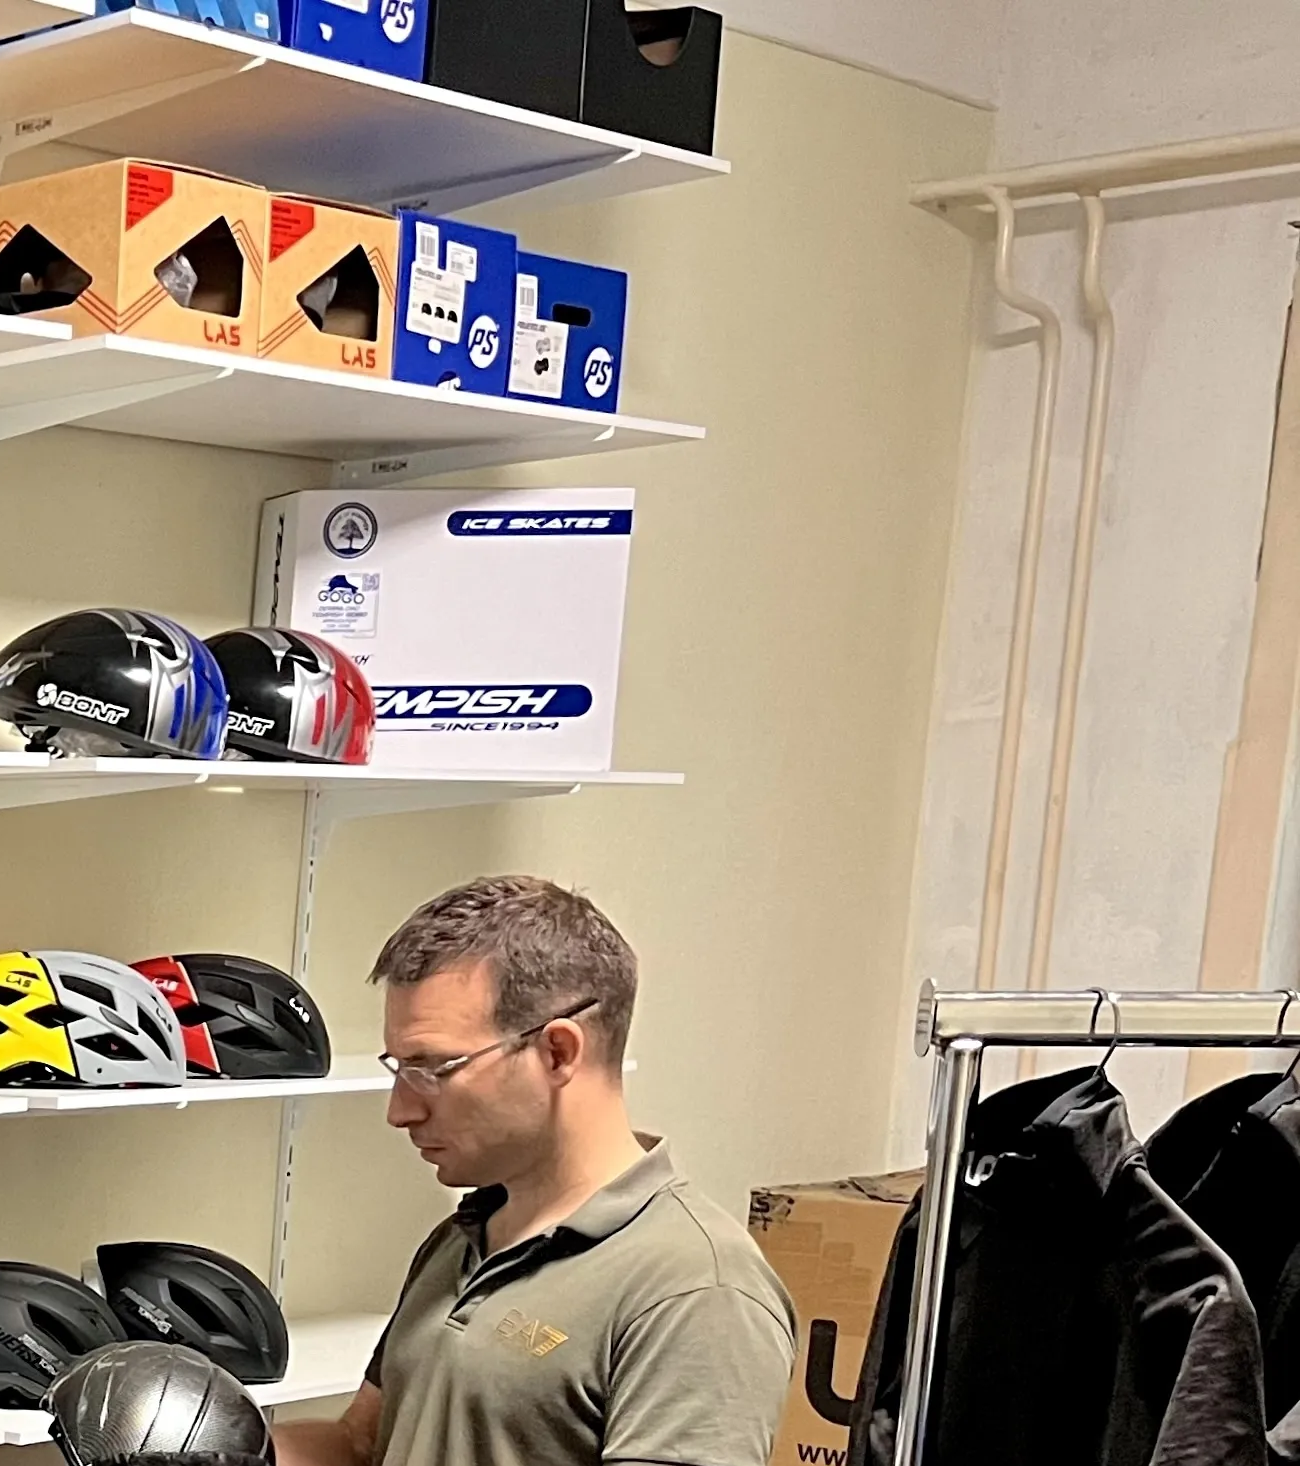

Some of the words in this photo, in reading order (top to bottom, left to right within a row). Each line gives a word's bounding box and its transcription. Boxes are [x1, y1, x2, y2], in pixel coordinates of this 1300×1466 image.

[203, 321, 241, 347] LAS
[469, 328, 499, 355] PS
[342, 343, 377, 369] LAS
[585, 360, 613, 386] PS
[462, 518, 504, 530] ICE
[507, 517, 611, 529] SKATES
[318, 590, 365, 604] GOGO
[54, 691, 129, 725] BONT
[374, 688, 558, 716] EMPISH
[226, 711, 275, 736] ONT
[5, 973, 33, 989] LAS
